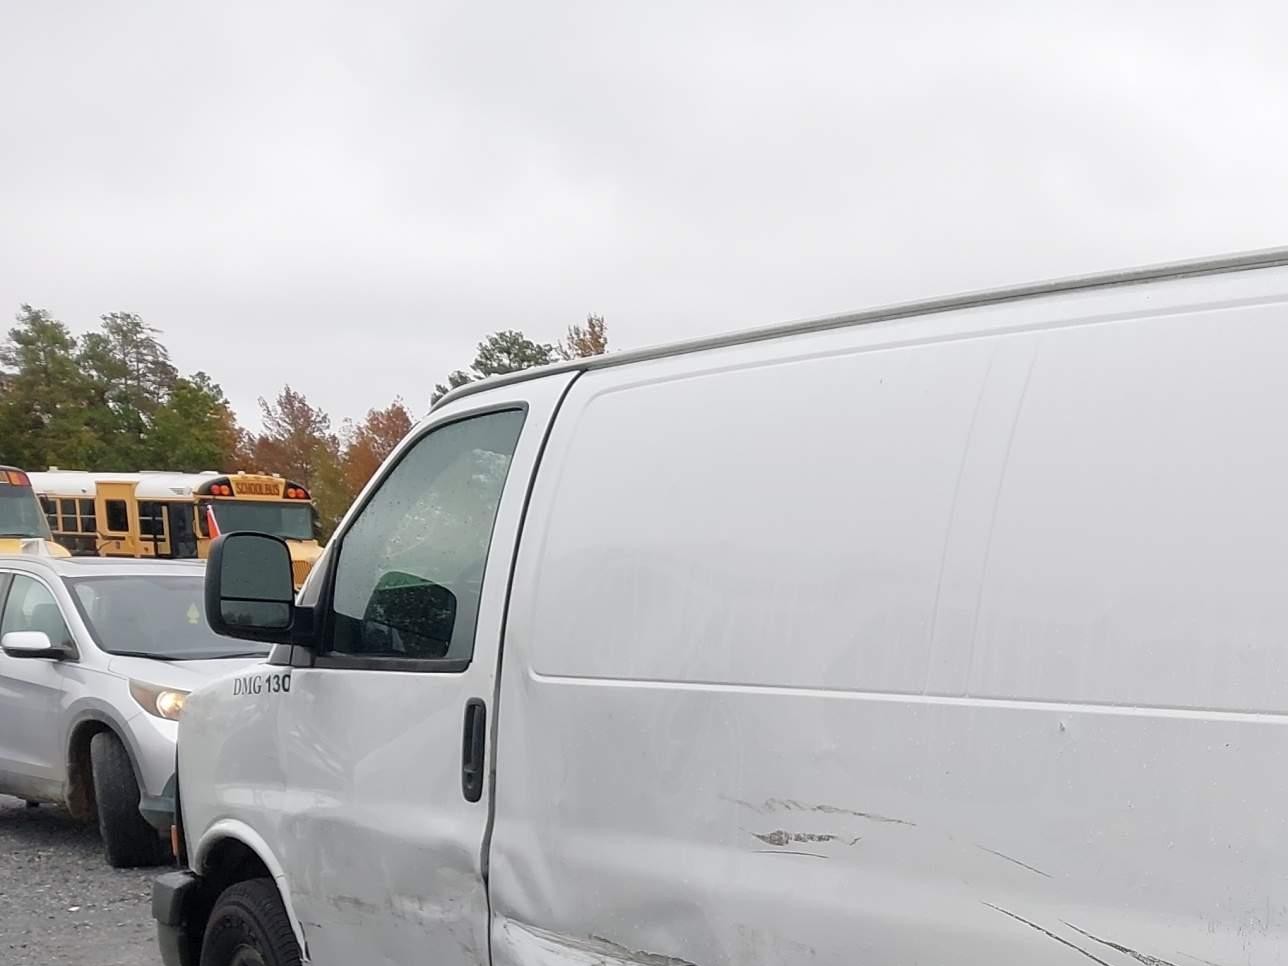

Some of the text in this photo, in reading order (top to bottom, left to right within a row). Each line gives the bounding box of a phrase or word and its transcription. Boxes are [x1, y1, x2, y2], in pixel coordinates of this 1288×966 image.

[236, 482, 280, 496] SCHOOL BUS
[233, 674, 291, 696] DMG 130
